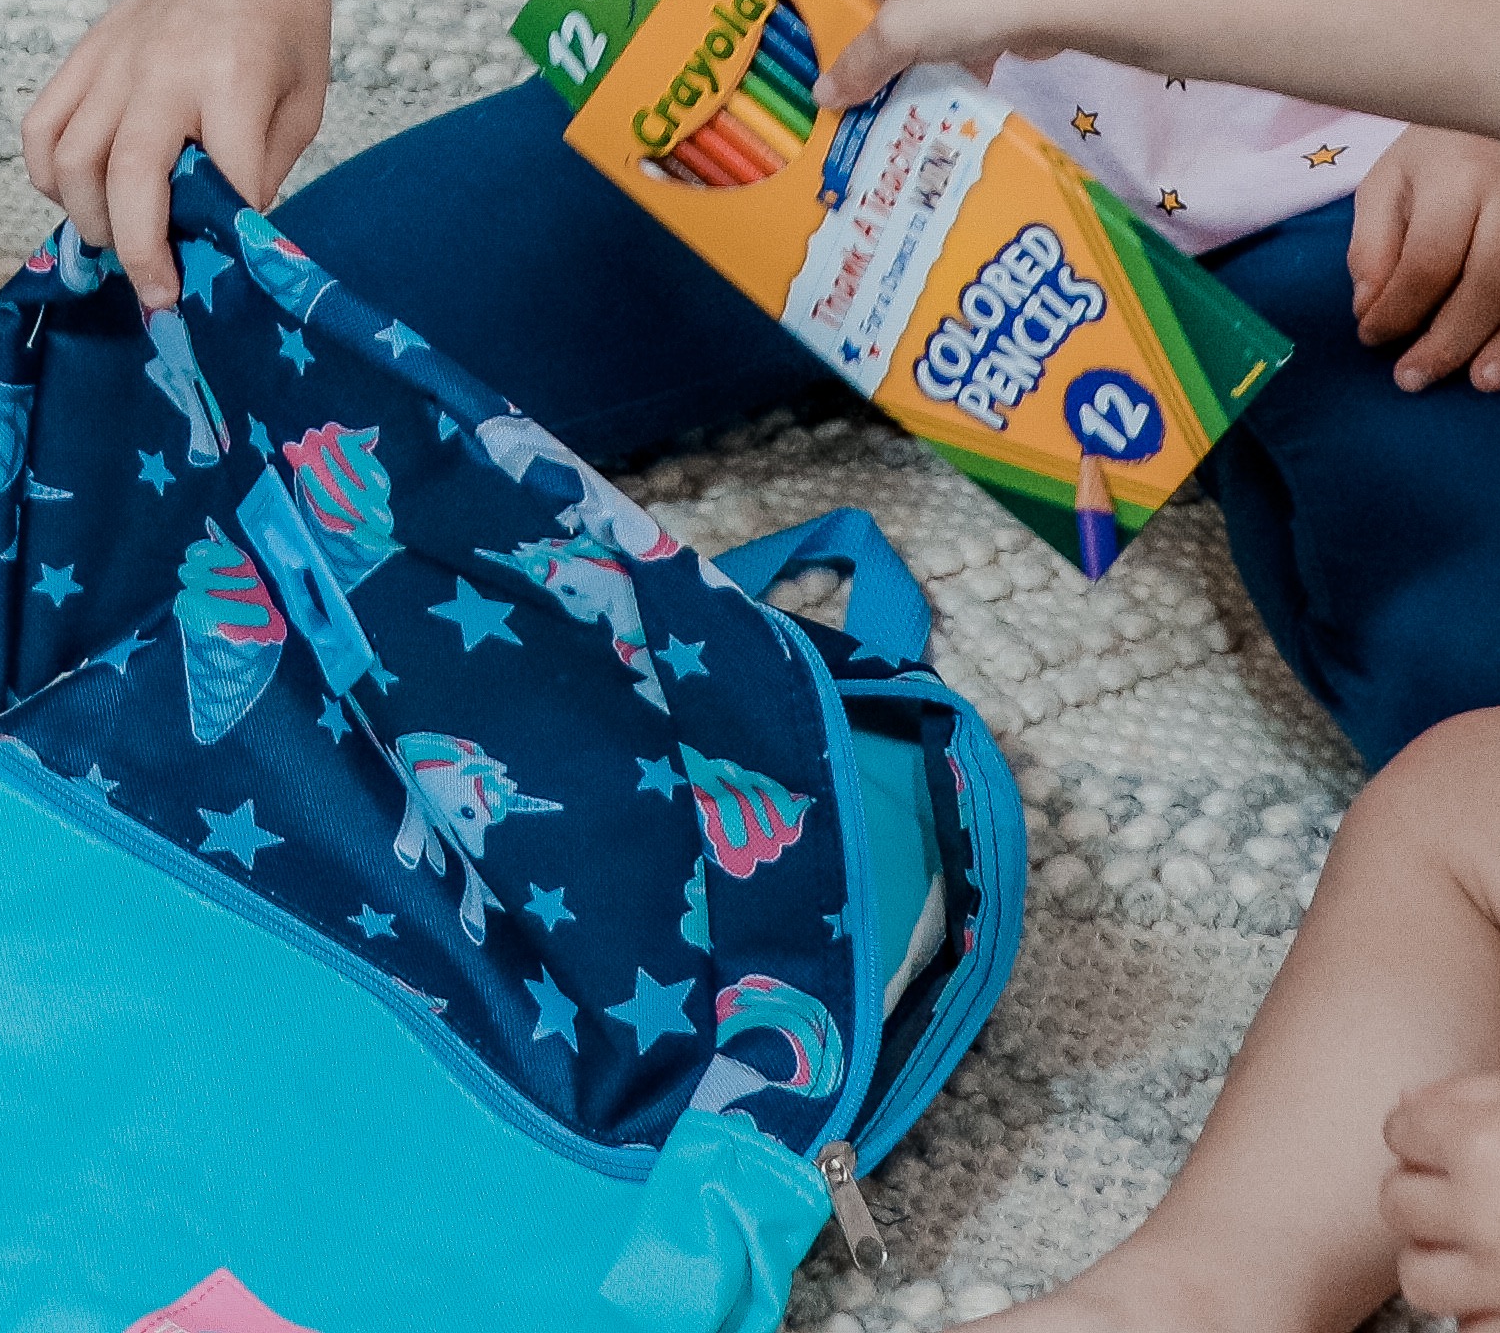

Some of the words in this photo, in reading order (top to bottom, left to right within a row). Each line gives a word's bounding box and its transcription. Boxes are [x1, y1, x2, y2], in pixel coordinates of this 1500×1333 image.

[548, 9, 608, 85] 12
[916, 224, 1062, 401] COLORED
[957, 263, 1104, 430] PENCILS
[1079, 383, 1150, 453] 12
